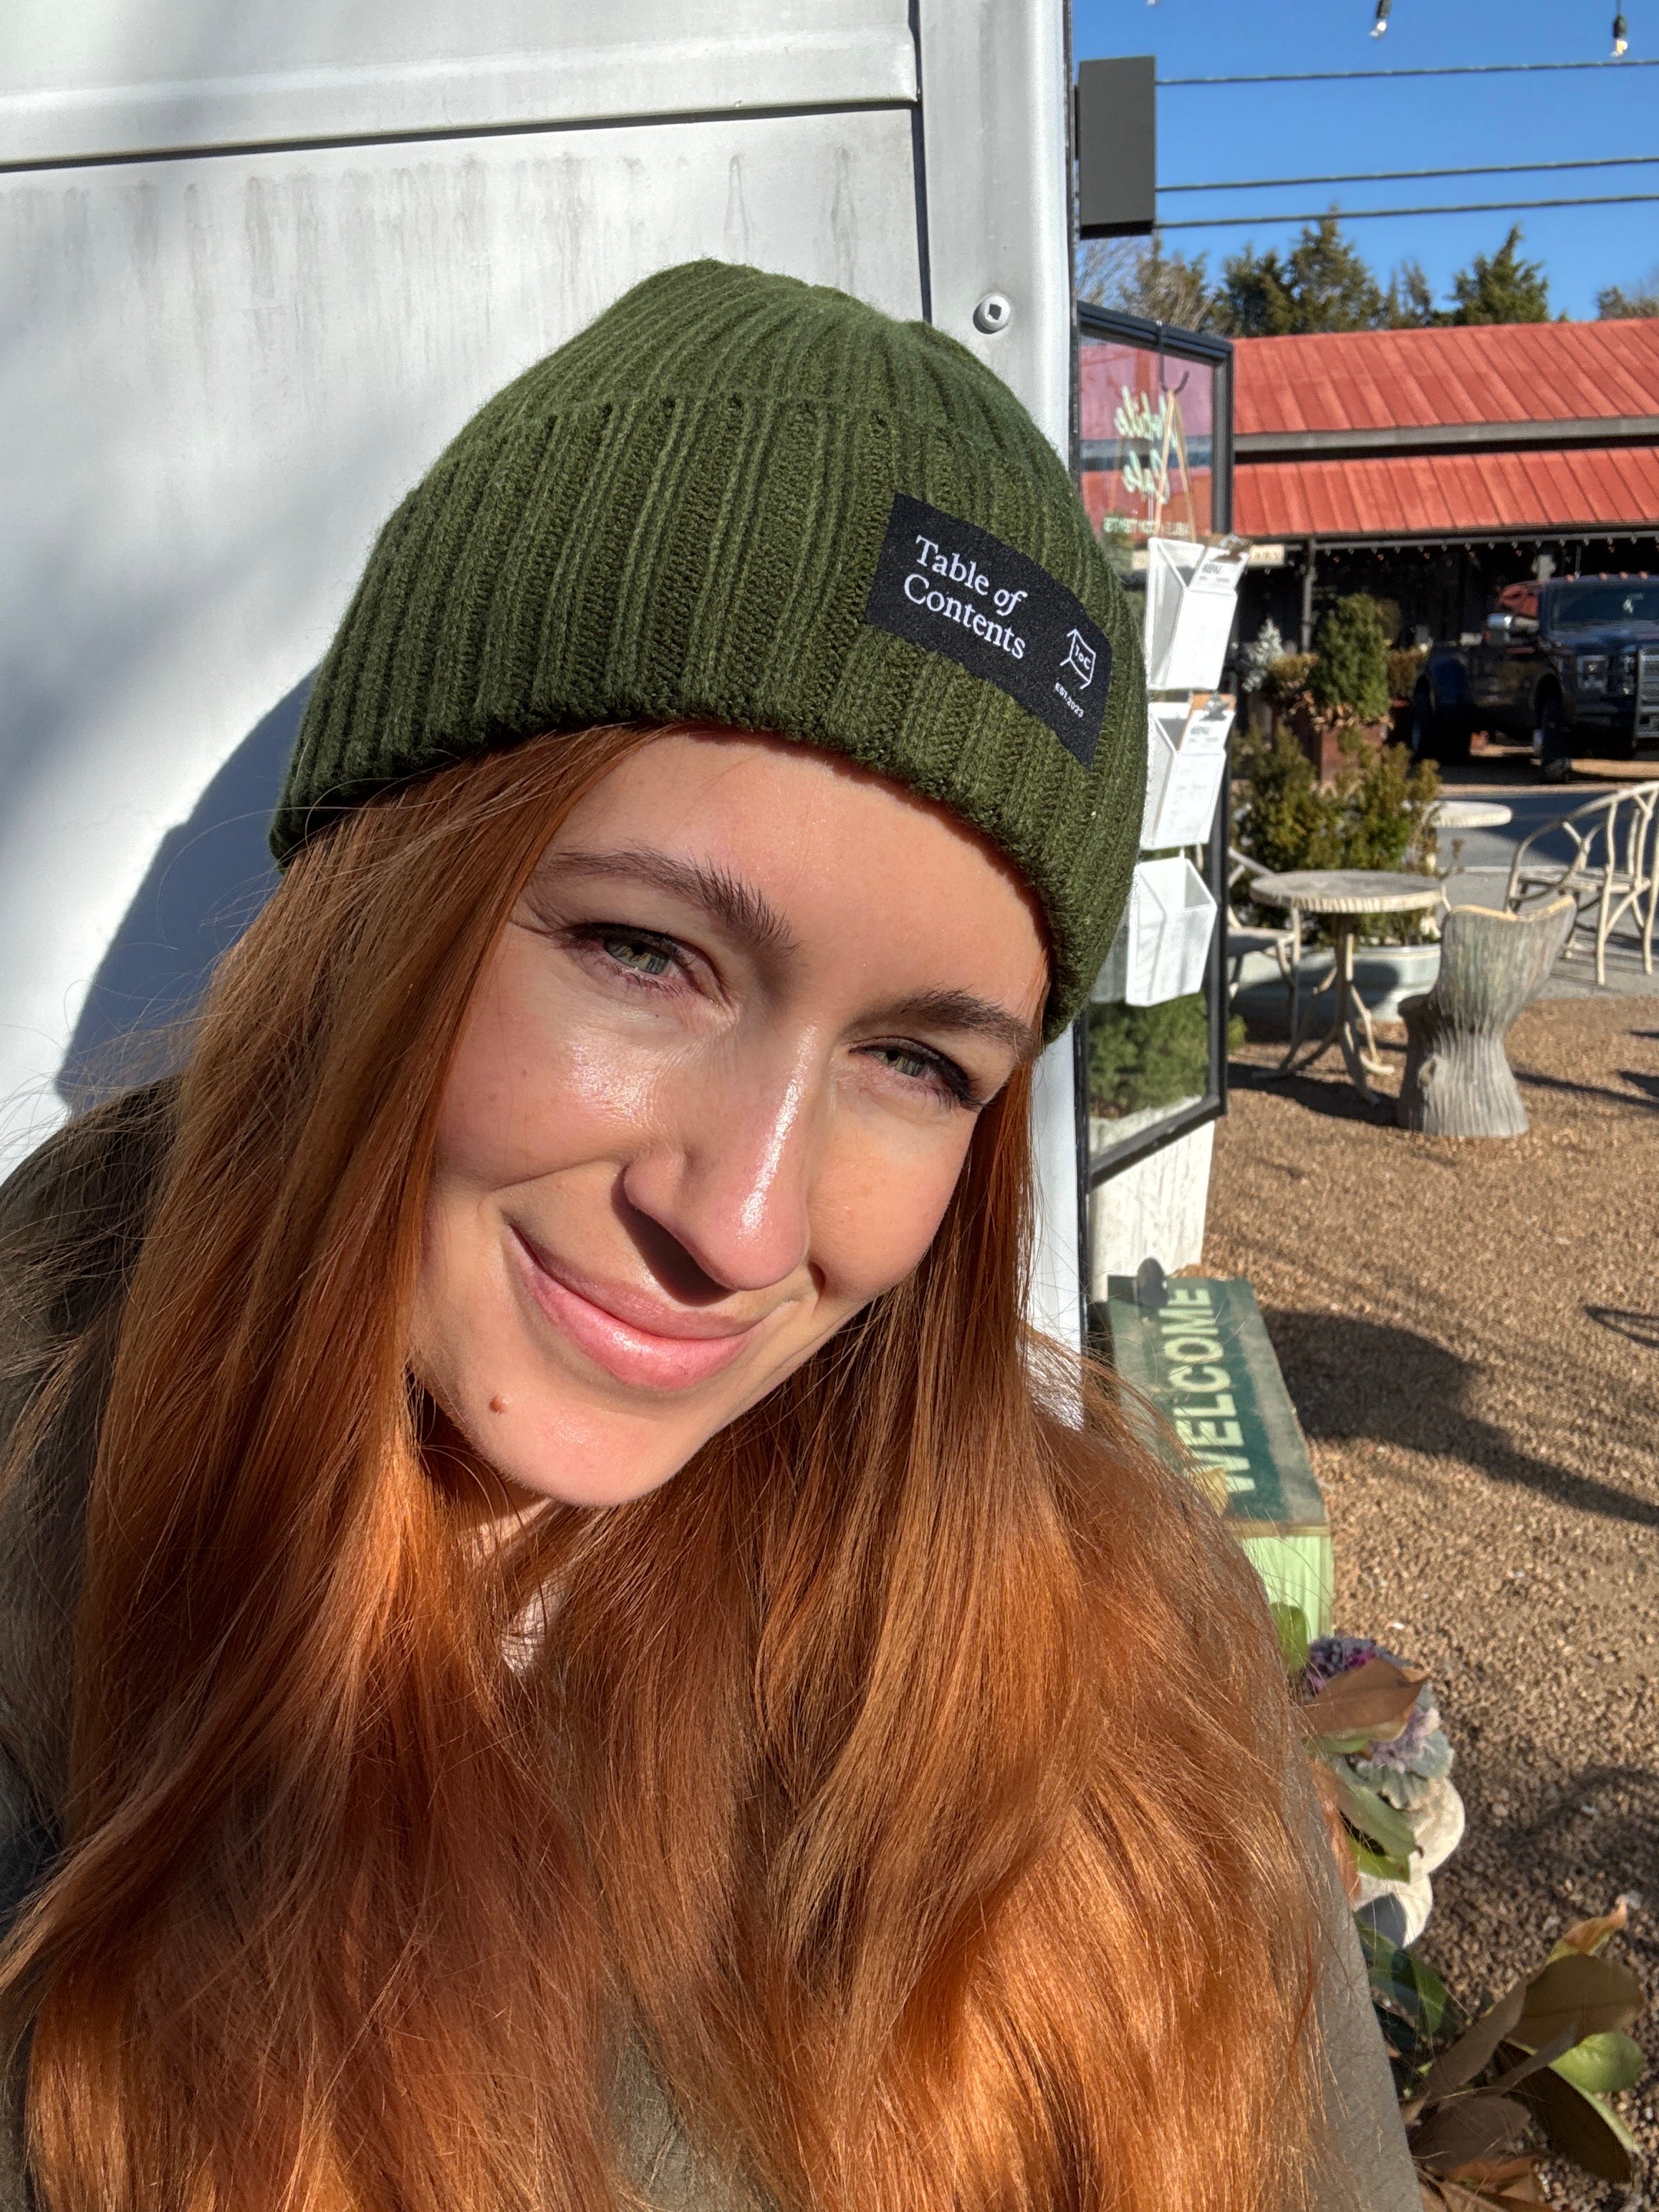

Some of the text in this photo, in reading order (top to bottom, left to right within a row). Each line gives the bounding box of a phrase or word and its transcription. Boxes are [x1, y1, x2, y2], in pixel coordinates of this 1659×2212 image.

[903, 573, 1026, 660] Contents
[915, 534, 1029, 617] Table of
[1158, 1289, 1256, 1493] WELCOME
